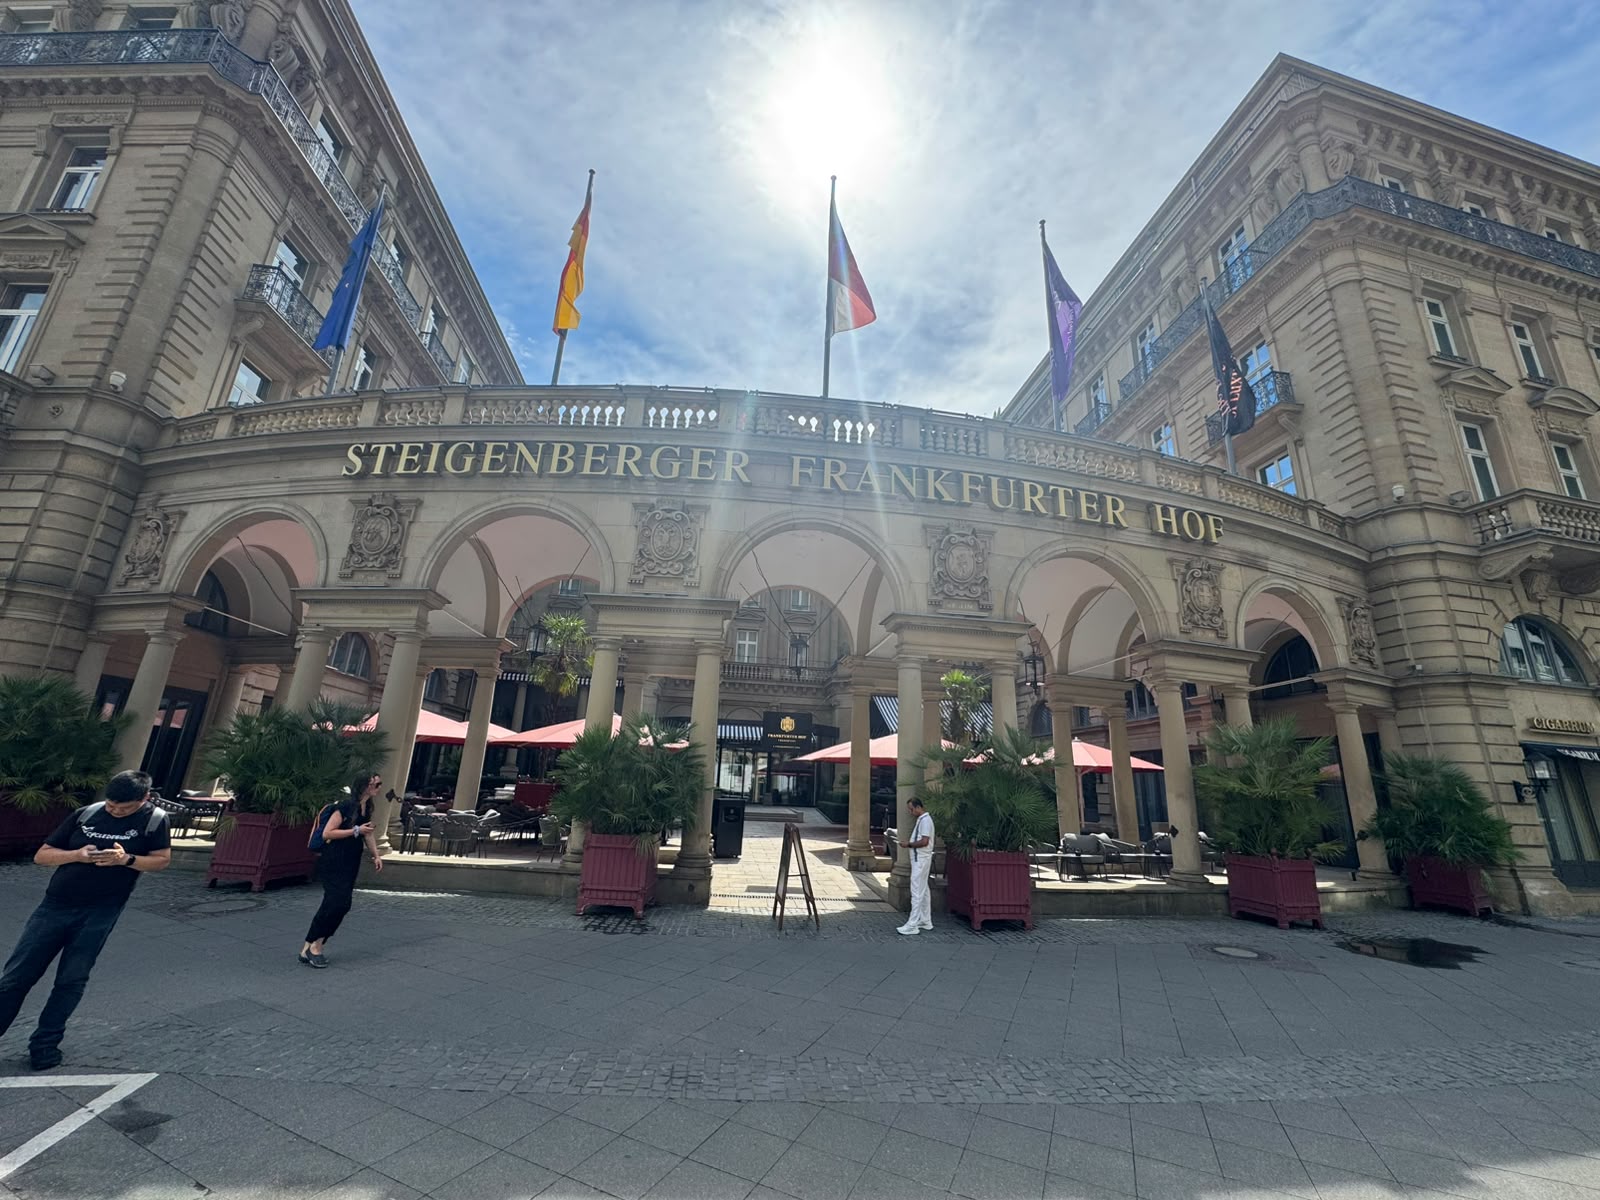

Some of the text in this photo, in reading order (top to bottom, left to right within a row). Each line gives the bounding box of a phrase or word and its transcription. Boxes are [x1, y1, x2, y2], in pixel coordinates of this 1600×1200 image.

[341, 440, 1225, 544] STEIGENBERGER FRANKFURTER HOF
[1533, 717, 1596, 733] CIGARRUM
